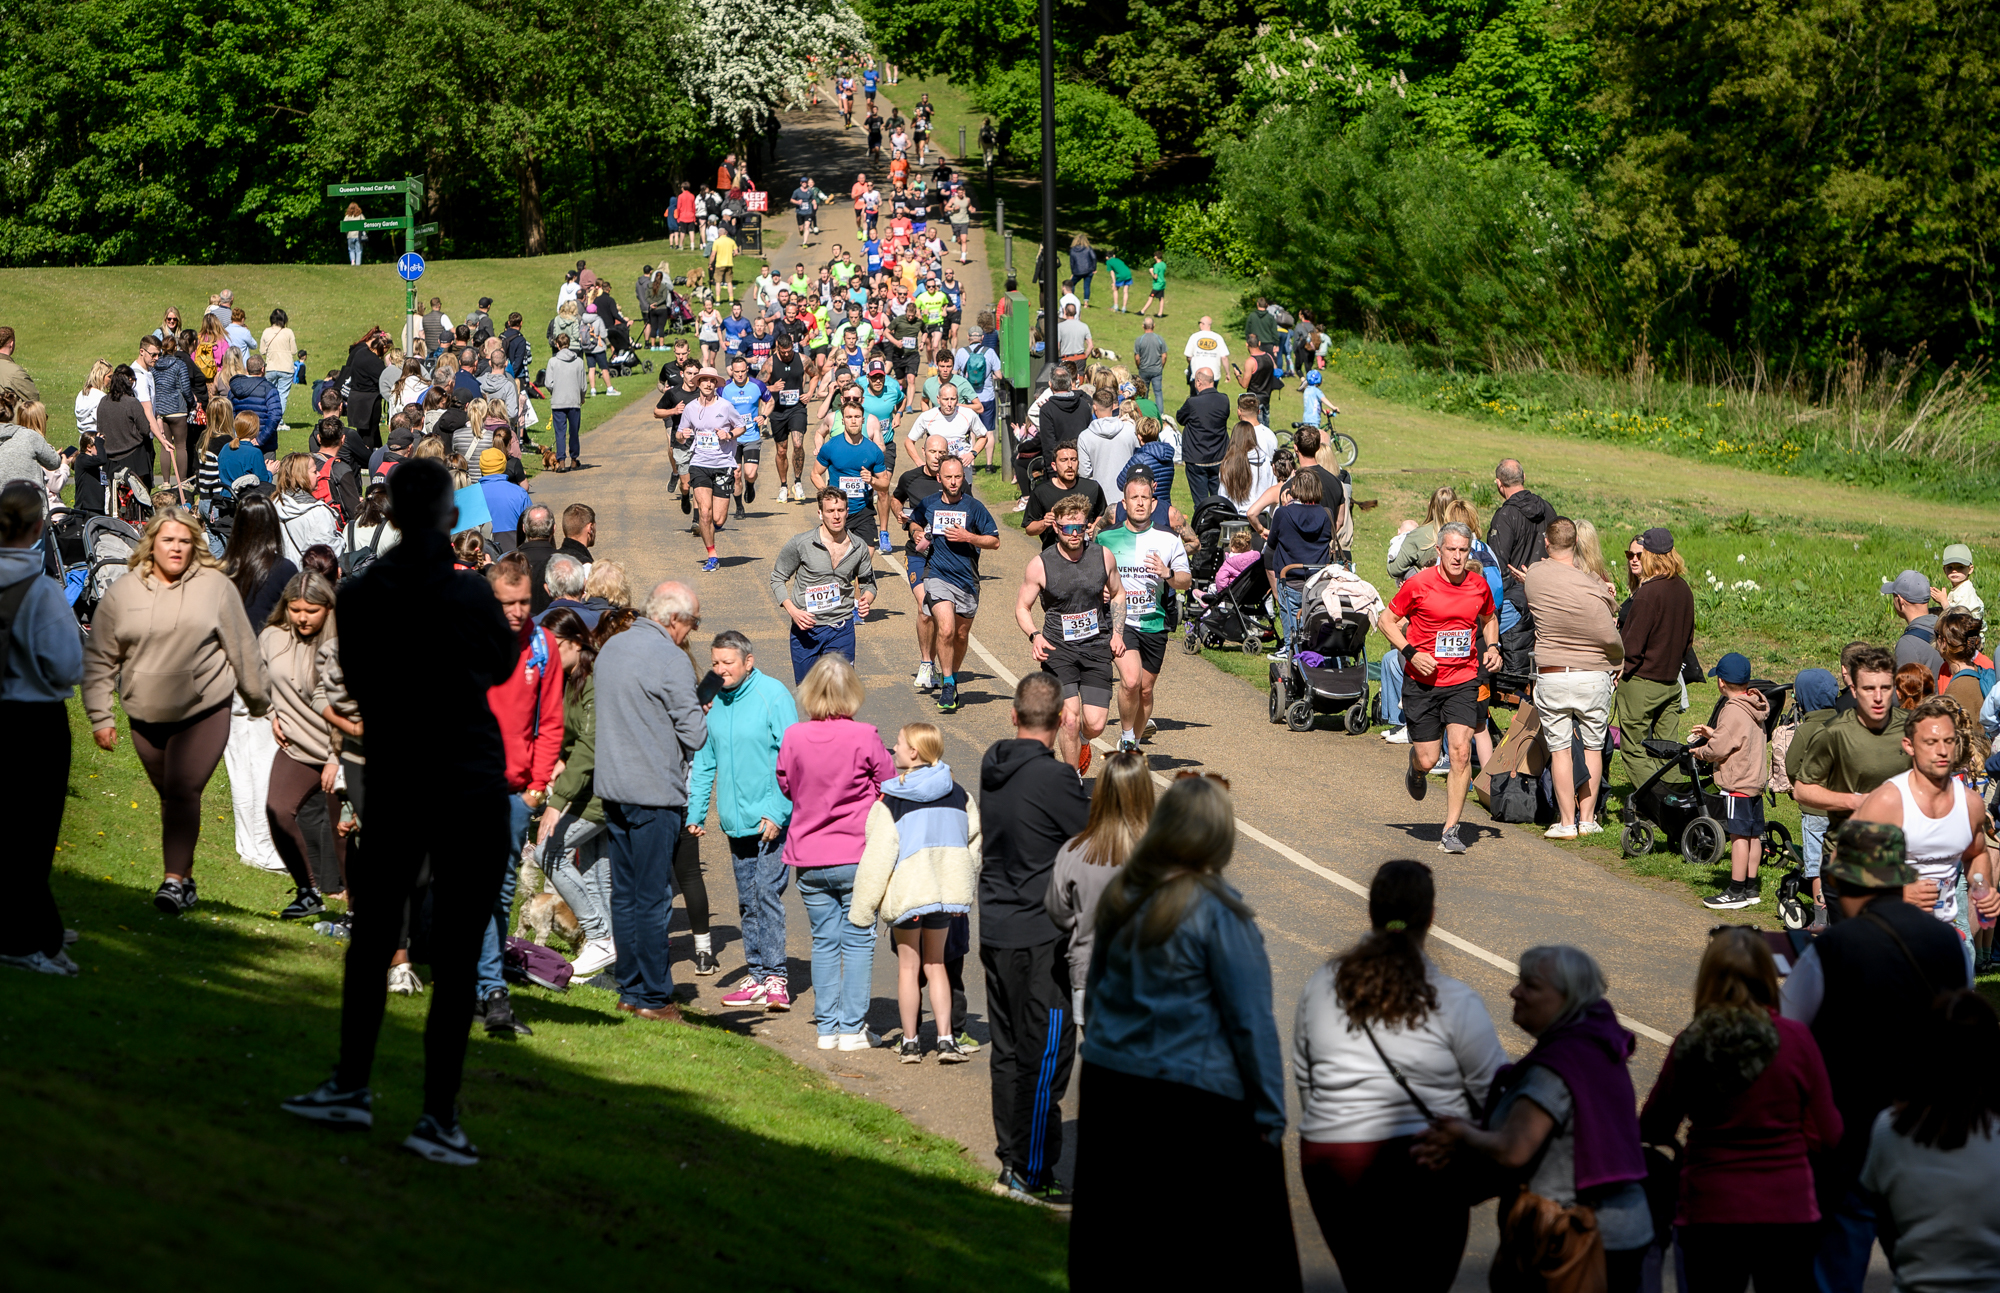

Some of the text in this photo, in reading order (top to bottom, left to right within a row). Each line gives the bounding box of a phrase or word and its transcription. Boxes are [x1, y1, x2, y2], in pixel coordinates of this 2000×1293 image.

[743, 192, 766, 201] KEEP
[938, 517, 962, 525] 1383
[810, 590, 835, 601] 1071
[1126, 595, 1152, 605] 1064
[1070, 617, 1092, 629] 353
[1441, 637, 1469, 646] 1152
